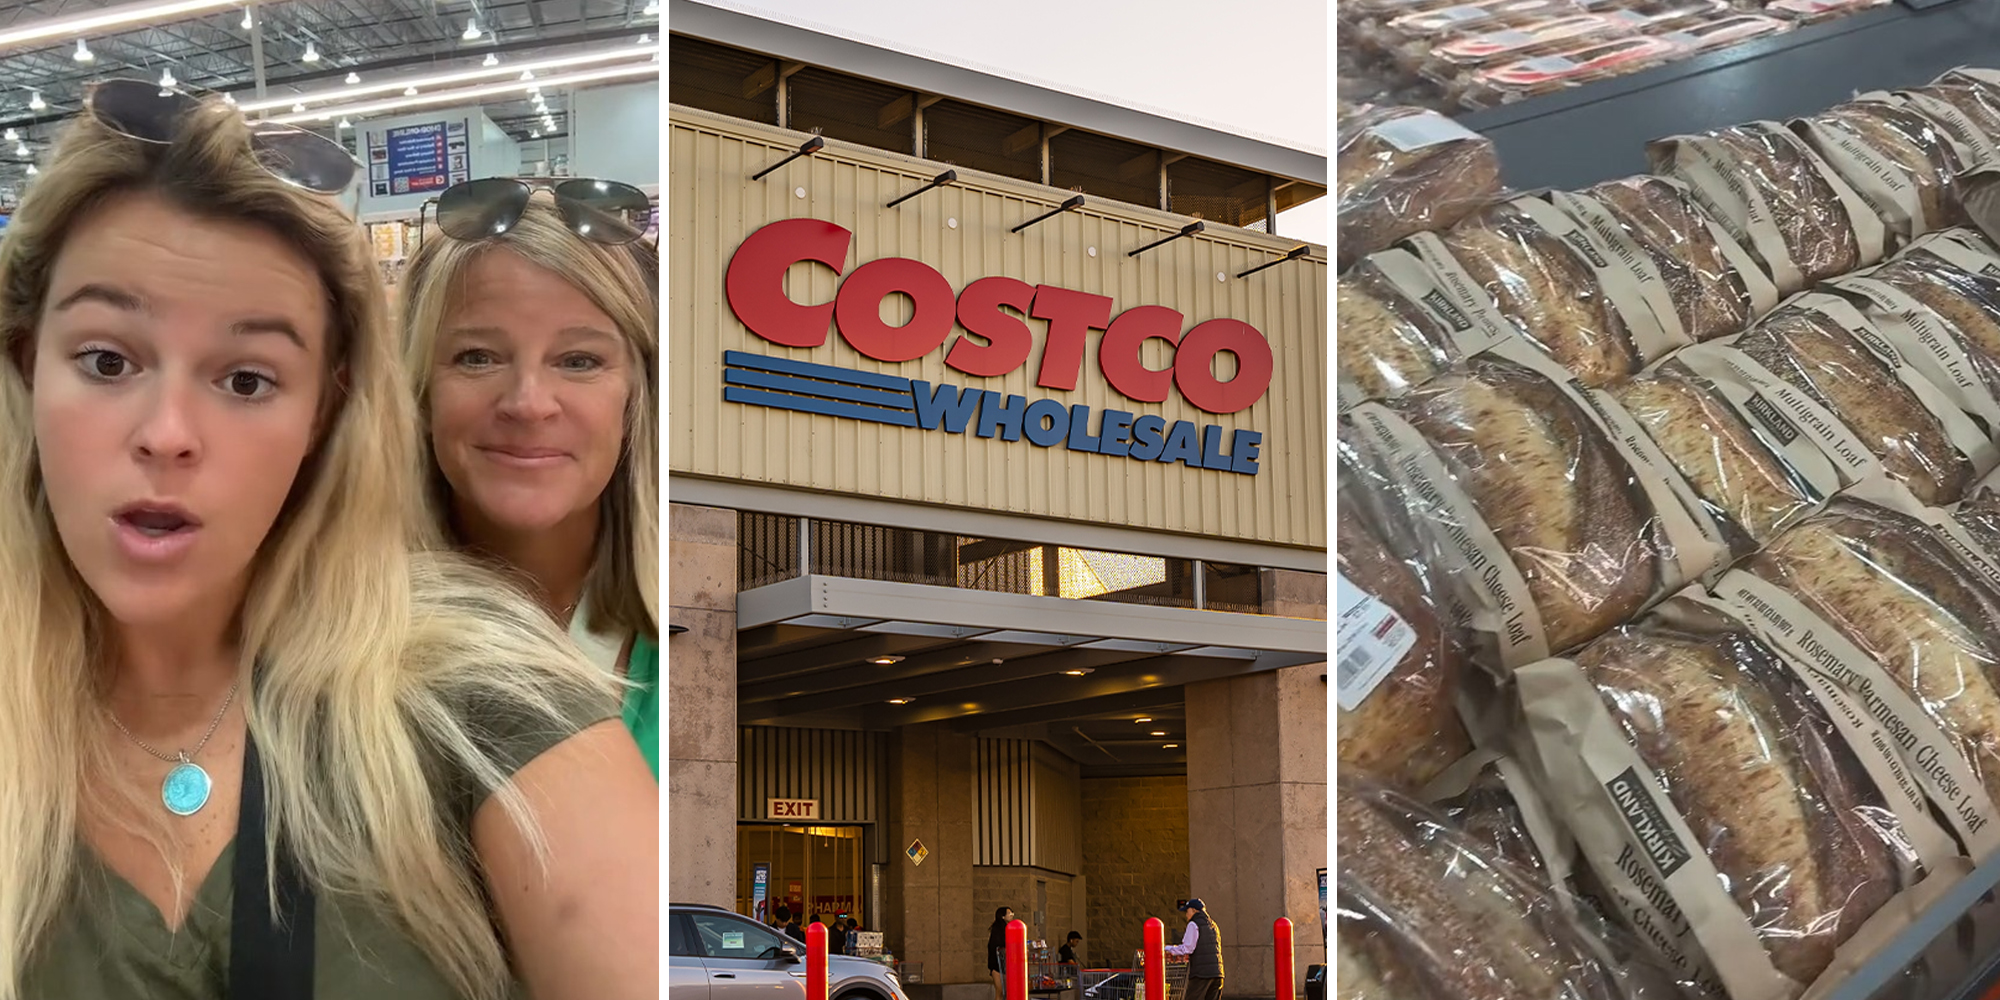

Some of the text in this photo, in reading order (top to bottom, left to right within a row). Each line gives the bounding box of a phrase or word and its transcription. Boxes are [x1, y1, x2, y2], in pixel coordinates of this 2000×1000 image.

[1840, 139, 1906, 191] Multigrain Loaf
[1590, 214, 1655, 283] Multigrain Loaf
[726, 218, 1273, 414] COSTCO
[1429, 291, 1469, 329] KIRKLAND
[1860, 327, 1899, 368] KIRKLAND
[1900, 308, 1974, 389] Multigrain Loaf
[911, 379, 1262, 475] WHOLESALE
[1751, 394, 1795, 440] KIRKLAND
[1775, 388, 1867, 468] Multigrain Loaf
[1482, 564, 1516, 616] Cheese
[1506, 611, 1532, 647] Loaf
[1796, 629, 1988, 834] Rosemary Parmesan Cheese Loaf
[774, 802, 813, 816] EXIT
[1612, 780, 1676, 870] KIRKLAND
